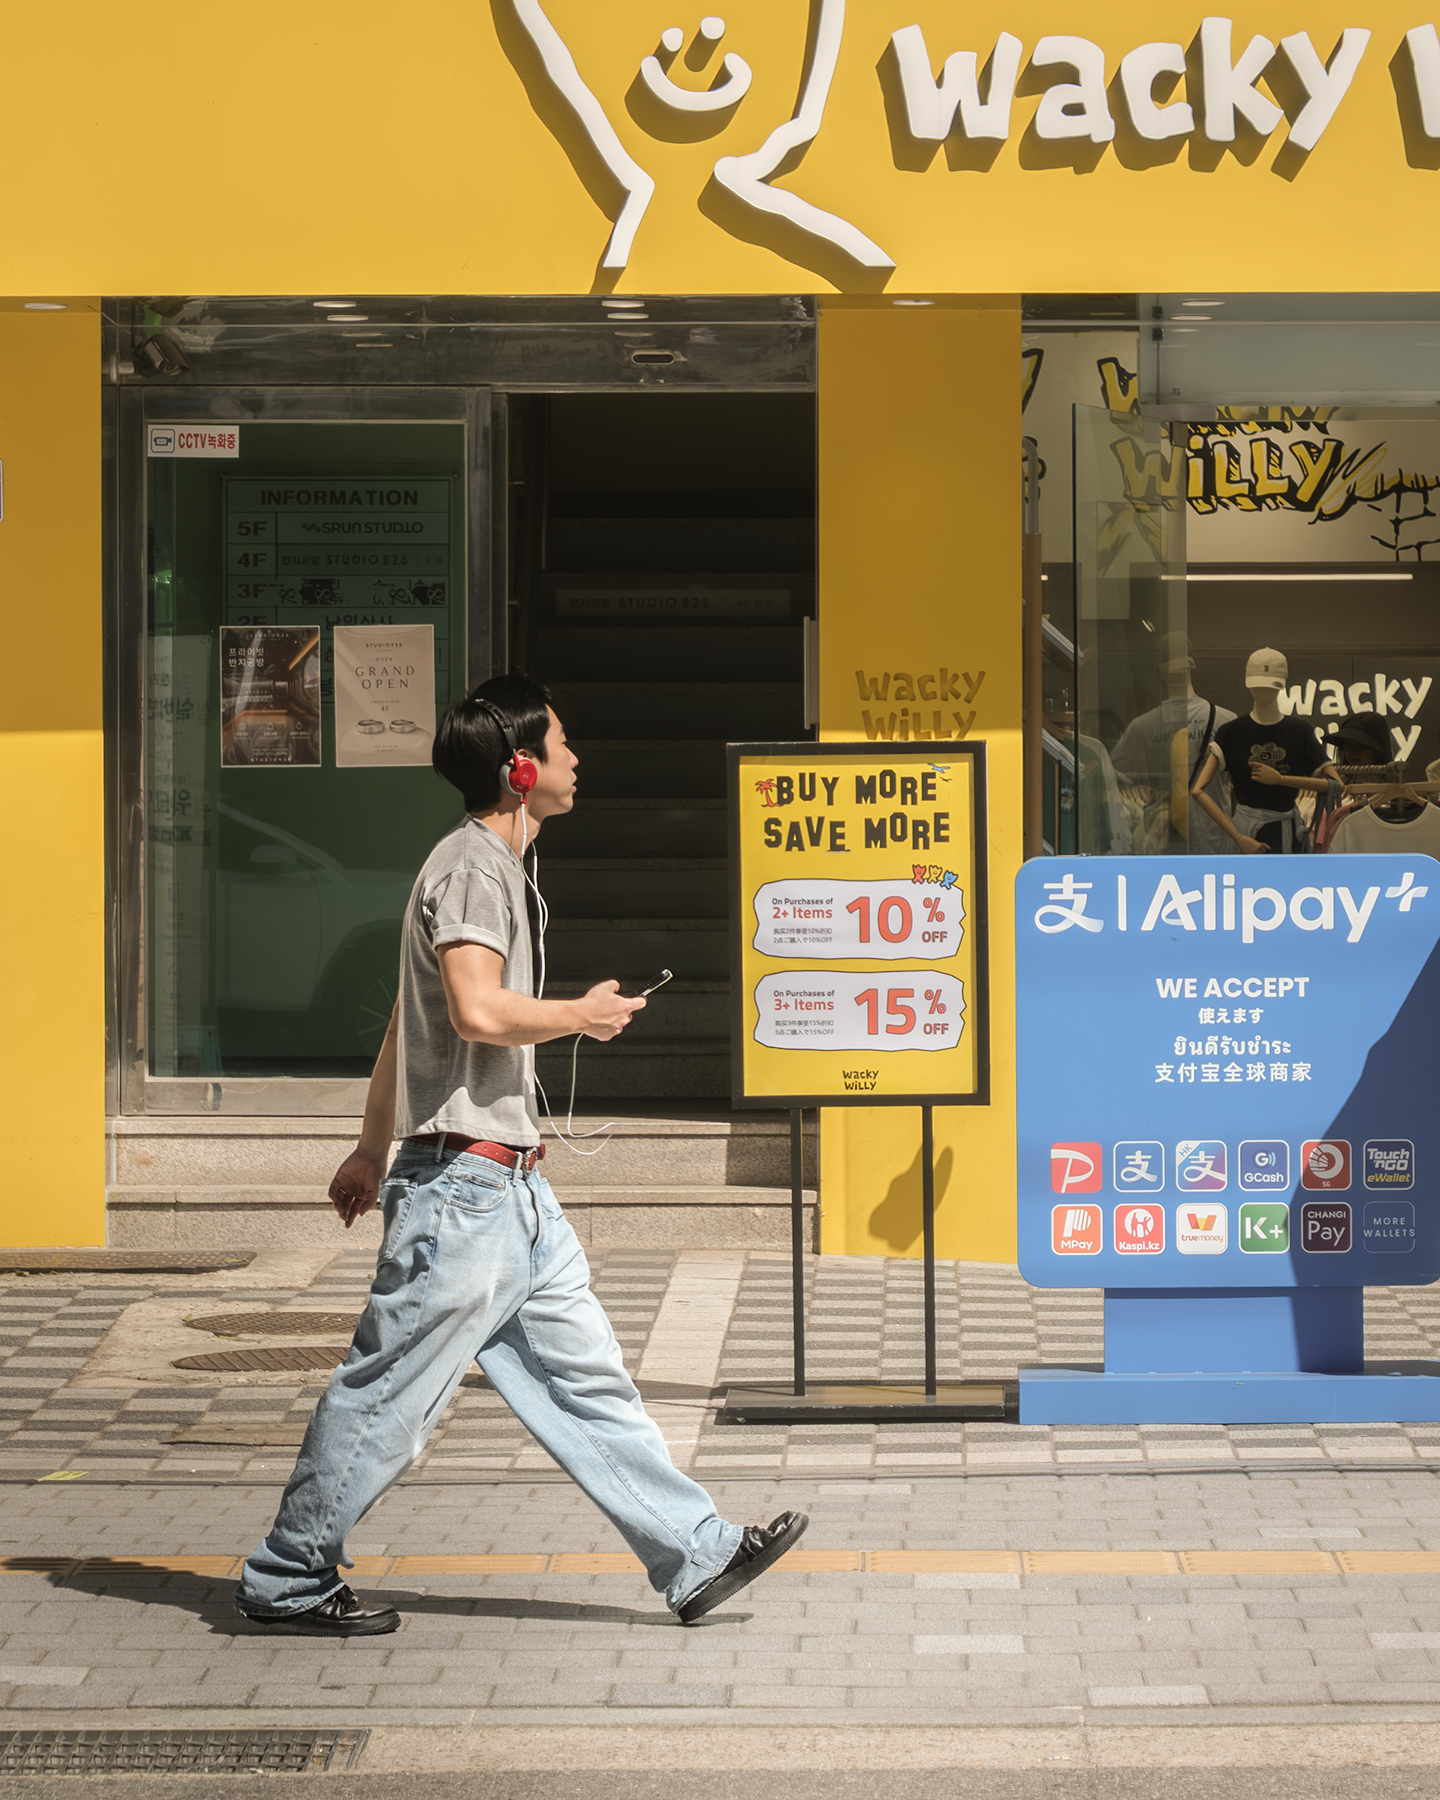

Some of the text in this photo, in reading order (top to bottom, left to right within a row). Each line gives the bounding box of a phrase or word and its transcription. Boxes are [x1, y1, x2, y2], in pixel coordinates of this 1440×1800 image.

[178, 432, 236, 449] CCTV녹화중
[261, 490, 418, 506] INFORMATION
[237, 522, 267, 536] 5F
[237, 553, 267, 567] 4F
[282, 555, 320, 566] 반지공방
[237, 584, 267, 598] 3F
[228, 647, 265, 657] 프라이빗
[228, 658, 265, 668] 반지공방
[355, 666, 415, 676] GRAND
[362, 679, 409, 689] OPEN
[777, 769, 937, 806] BUY MORE
[764, 812, 950, 852] SAVE MORE
[772, 907, 833, 919] 2+ Items
[846, 896, 945, 943] 10 %
[921, 931, 948, 943] OFF
[826, 989, 835, 997] of
[1156, 977, 1310, 998] WE ACCEPT
[774, 999, 834, 1010] 3+ Items
[854, 988, 947, 1035] 15 %
[1198, 1007, 1264, 1024] 使えます
[923, 1023, 949, 1035] OFF
[1174, 1035, 1292, 1056] ยินดีรับชำระ
[1155, 1062, 1312, 1083] 支付宝全球商家
[1179, 1143, 1193, 1158] HK
[1367, 1148, 1410, 1160] Touch
[1244, 1172, 1284, 1183] GCash
[1367, 1173, 1411, 1183] eWallet
[1307, 1210, 1347, 1219] CHANGI
[1373, 1217, 1406, 1225] MORE
[1245, 1217, 1284, 1240] K+
[1308, 1221, 1346, 1246] Pay
[1363, 1229, 1416, 1237] WALLETS
[1061, 1239, 1093, 1251] MPay
[1119, 1241, 1160, 1252] Kaspi.kz
